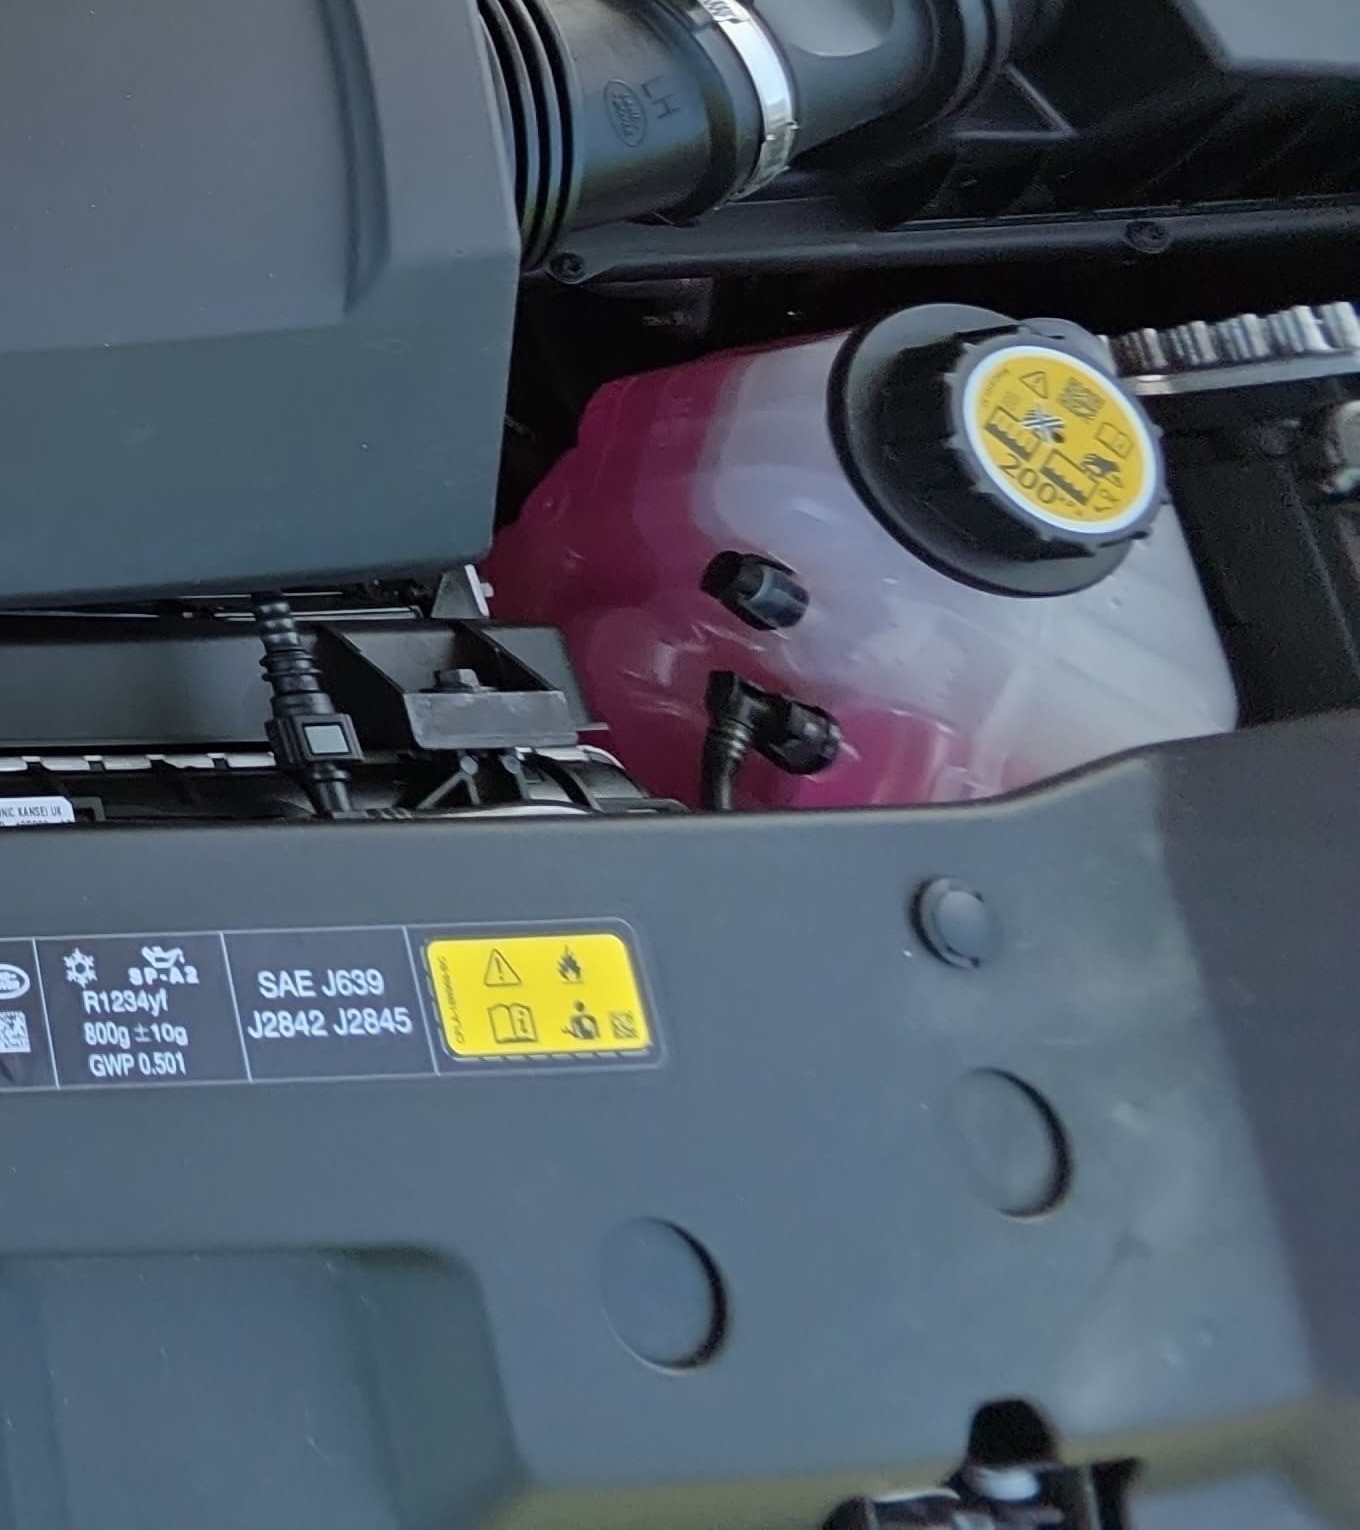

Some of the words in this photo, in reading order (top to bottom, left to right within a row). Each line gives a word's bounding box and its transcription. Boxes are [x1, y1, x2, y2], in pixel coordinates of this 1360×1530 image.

[640, 76, 681, 119] LH
[999, 453, 1058, 504] 200
[17, 806, 49, 817] KANSEI
[50, 805, 63, 815] UK
[257, 970, 317, 998] SAE
[322, 968, 385, 997] J639
[83, 988, 169, 1017] R1234yf
[83, 1022, 132, 1050] 800g
[248, 1010, 329, 1039] J2842
[333, 1006, 413, 1037] J2845
[88, 1053, 135, 1077] GWP
[138, 1052, 187, 1075] 0.501
